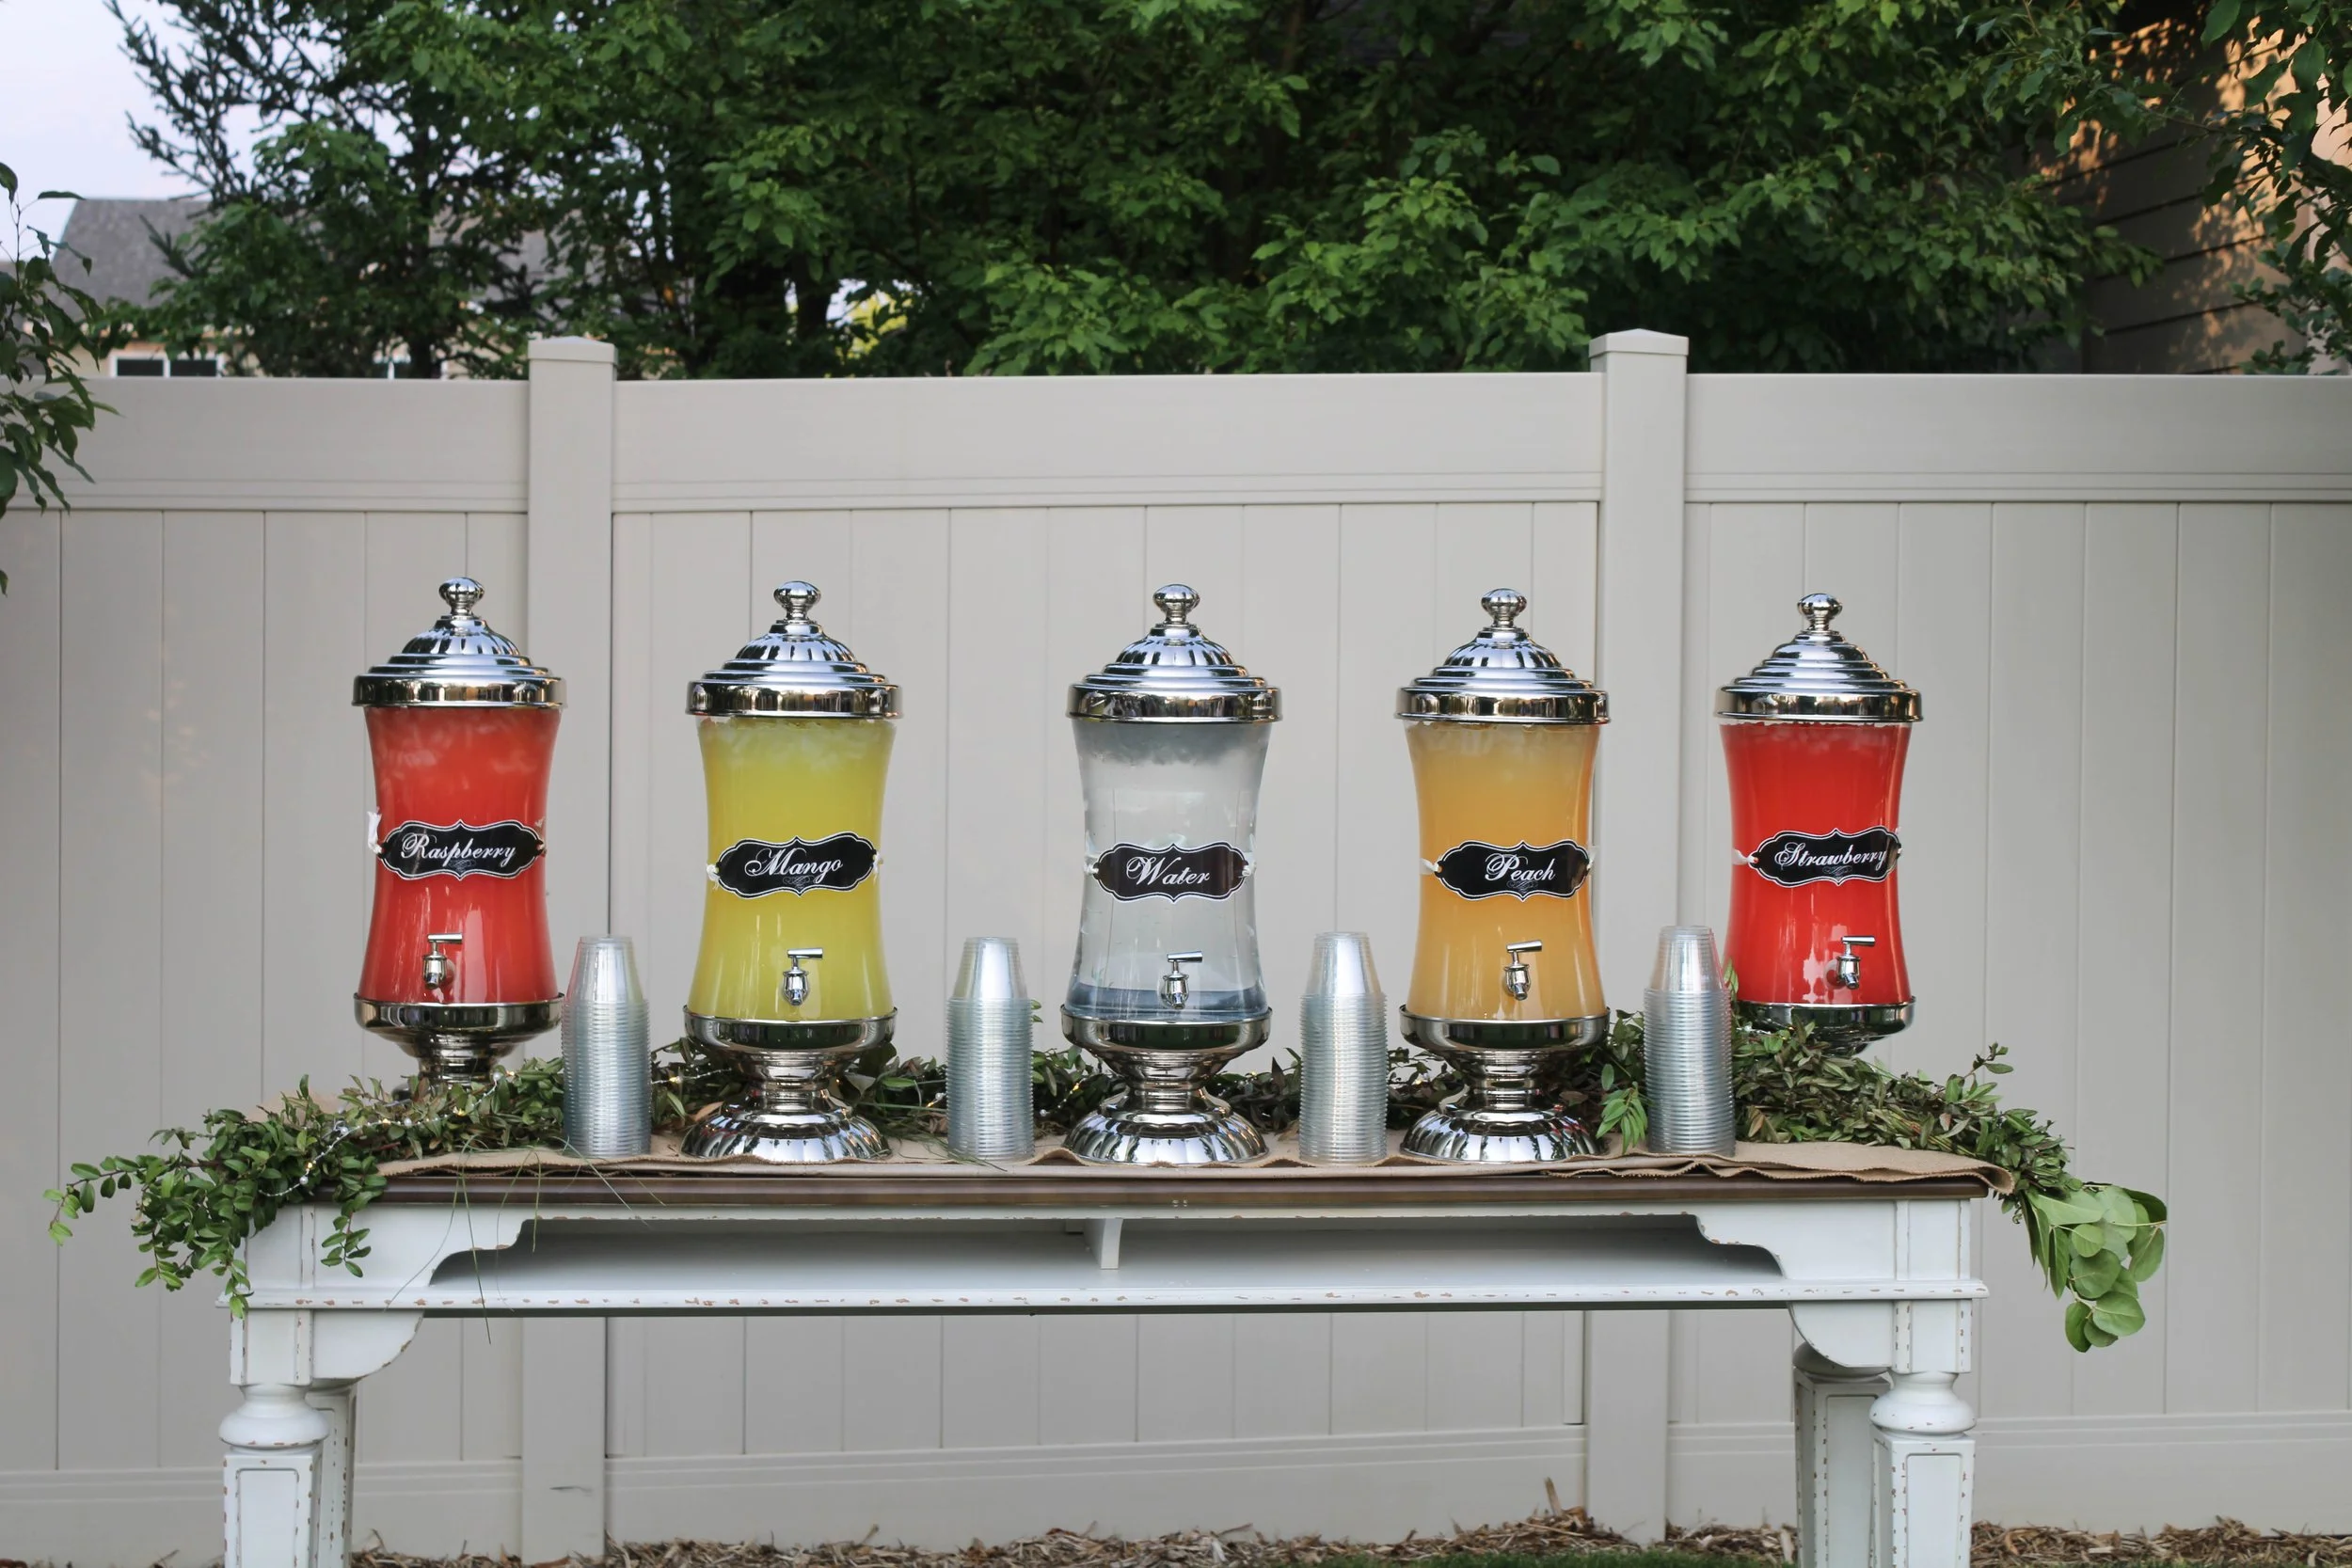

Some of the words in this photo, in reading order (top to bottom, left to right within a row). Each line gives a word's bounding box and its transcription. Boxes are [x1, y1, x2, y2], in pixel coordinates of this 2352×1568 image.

[401, 832, 516, 867] Raspberry
[1774, 842, 1887, 871] Strawberry
[744, 847, 843, 883] Mango
[1126, 857, 1210, 885] Water
[1485, 853, 1556, 880] Peach
